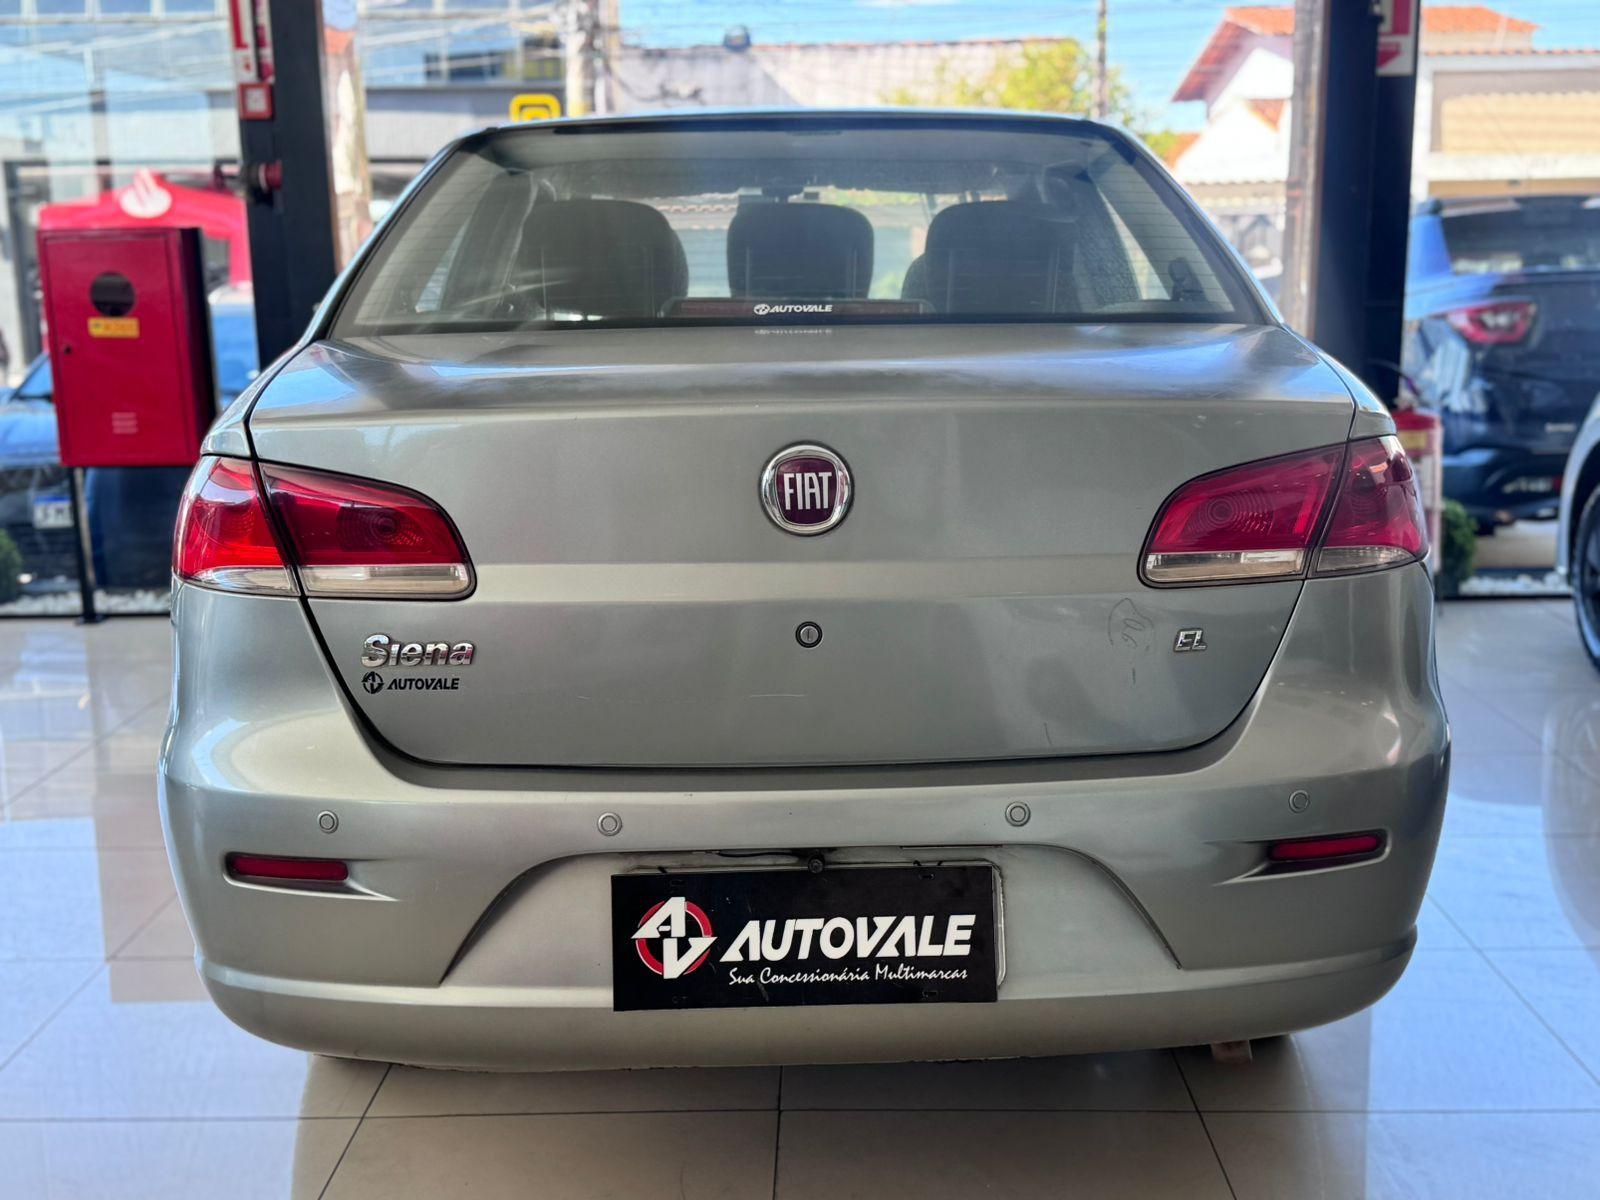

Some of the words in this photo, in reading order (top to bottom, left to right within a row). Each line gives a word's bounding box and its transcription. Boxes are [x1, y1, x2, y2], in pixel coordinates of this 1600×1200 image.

[769, 304, 833, 313] AUTOVALE
[783, 471, 832, 510] FIAT
[361, 633, 475, 668] Siena
[1174, 629, 1207, 651] EL
[387, 678, 460, 690] AUTOVALE
[719, 914, 976, 963] AUTOVALE
[728, 966, 755, 985] Sua
[760, 966, 870, 984] Concessionária
[875, 963, 968, 981] Multimarcas
